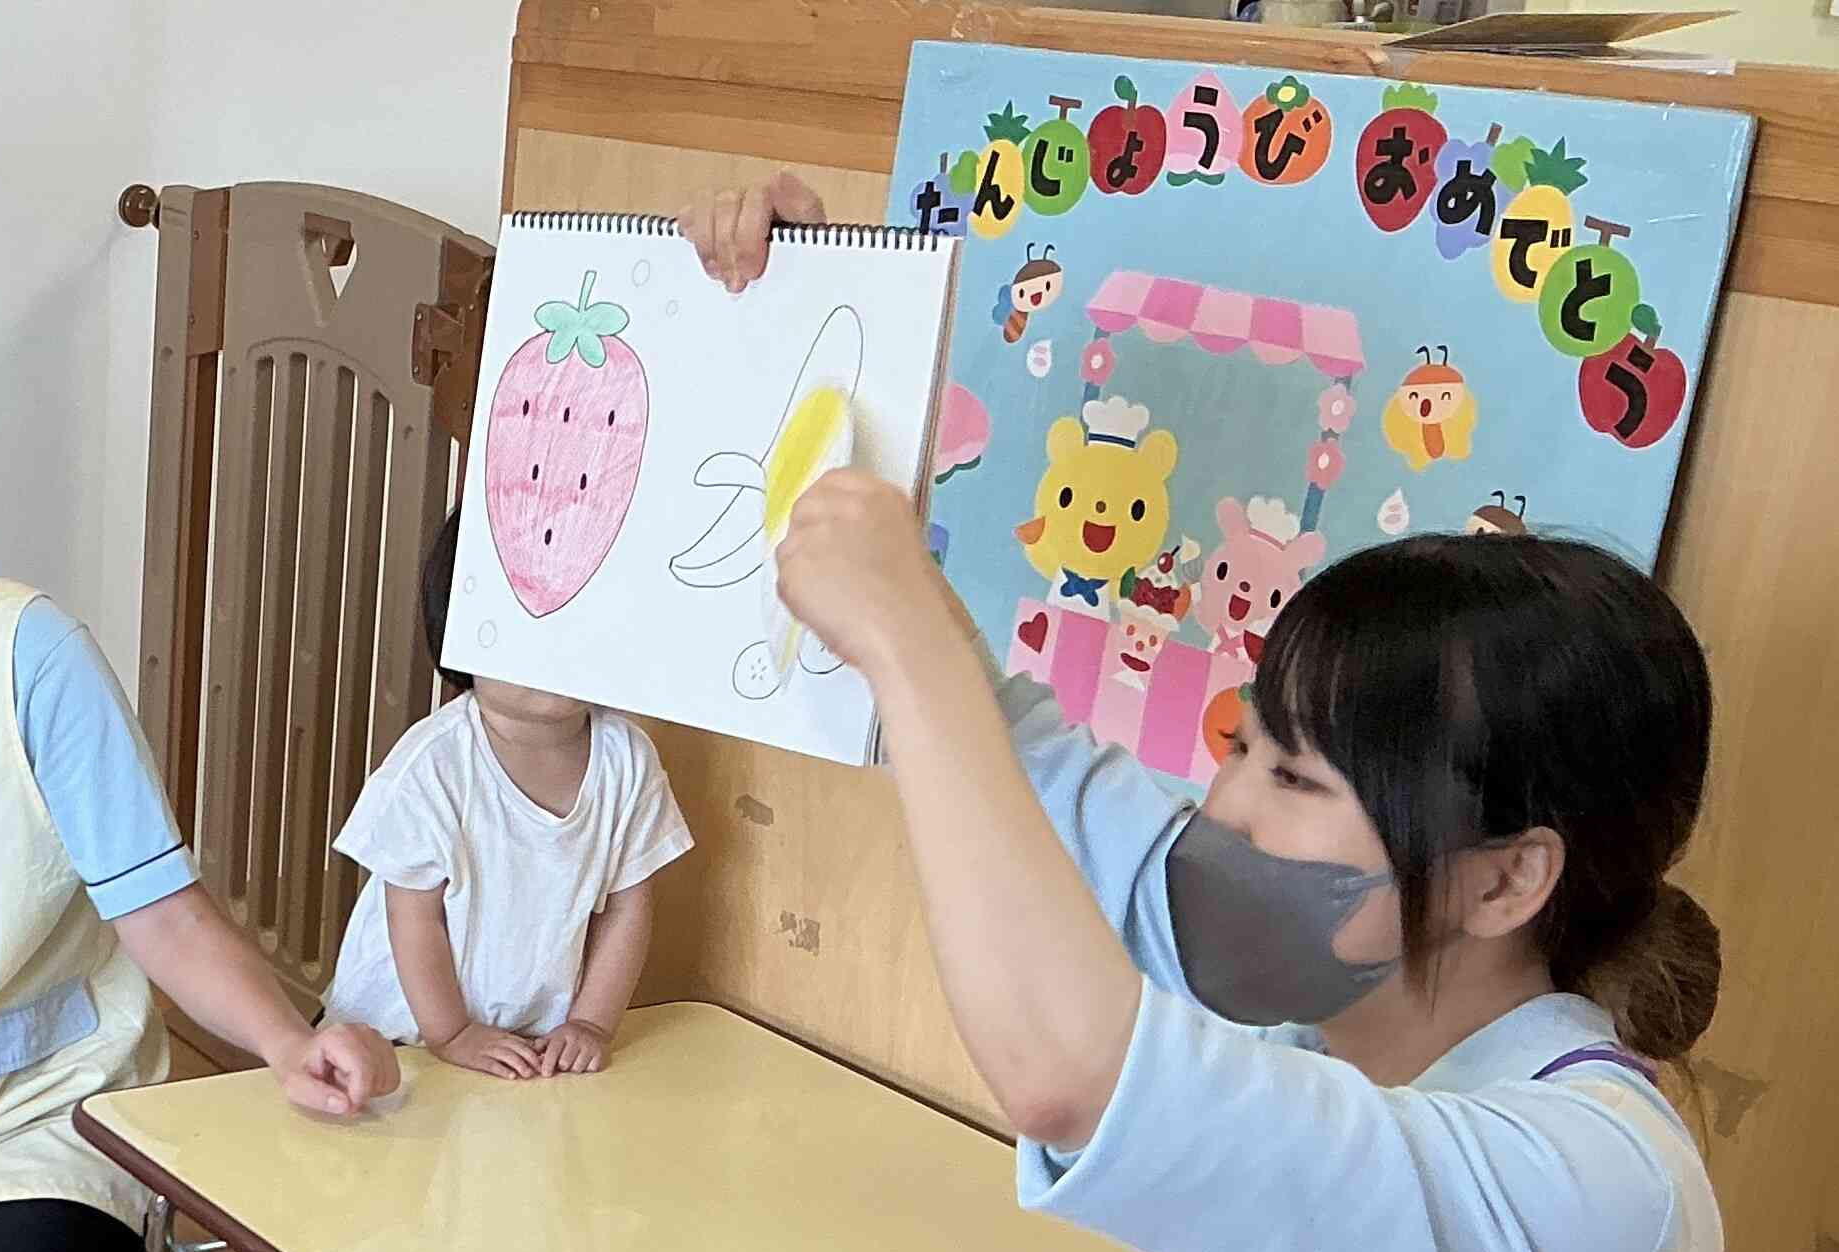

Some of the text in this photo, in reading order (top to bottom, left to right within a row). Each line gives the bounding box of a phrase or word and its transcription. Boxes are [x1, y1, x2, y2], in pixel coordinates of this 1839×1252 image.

[916, 85, 1655, 439] たんじょうび おめでとう
